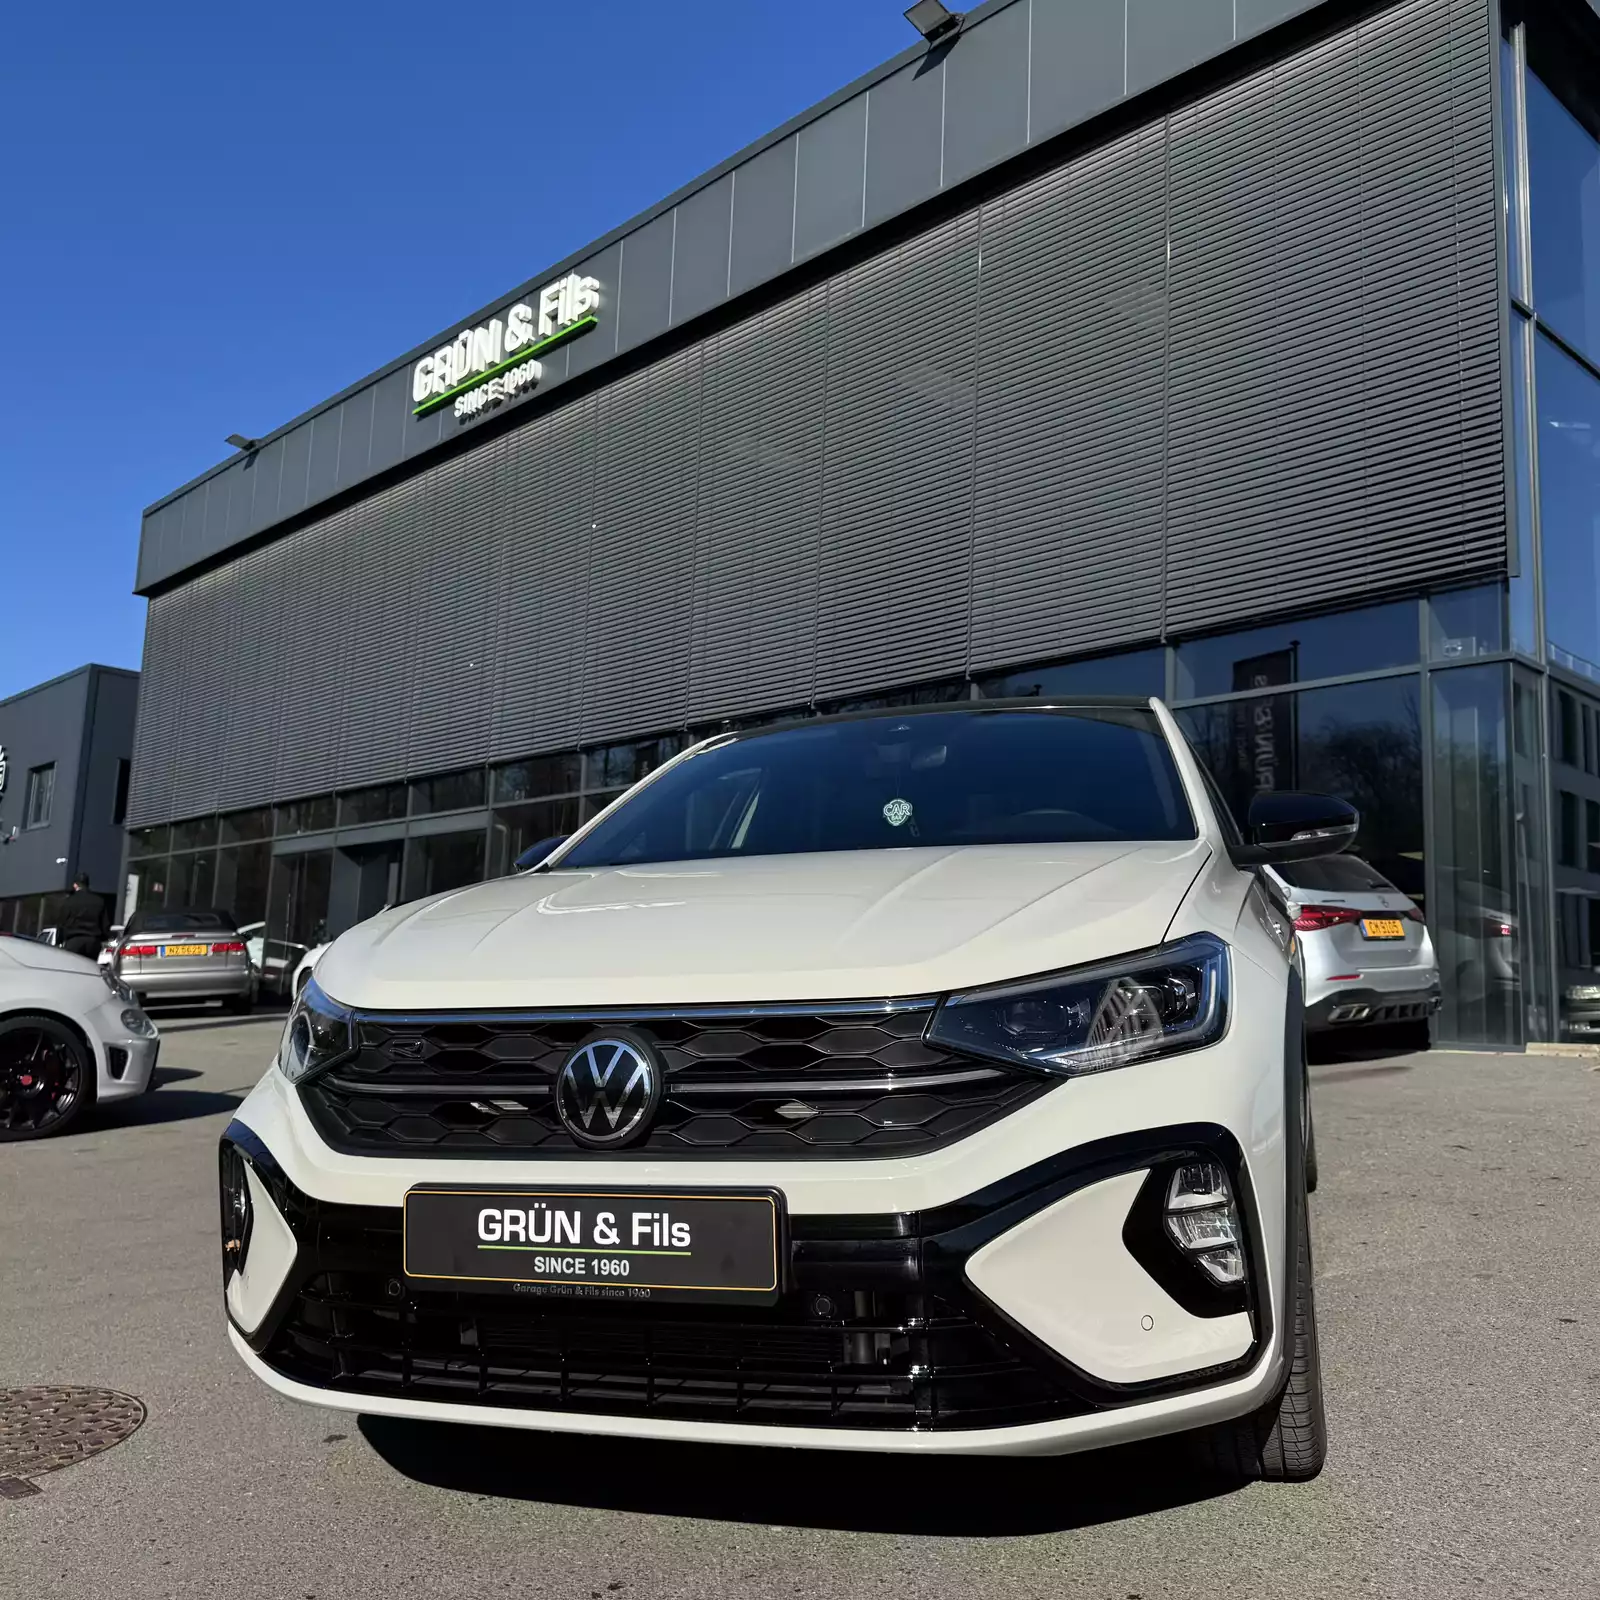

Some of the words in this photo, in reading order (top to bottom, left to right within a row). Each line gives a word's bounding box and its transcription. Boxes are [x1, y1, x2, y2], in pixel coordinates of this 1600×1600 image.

[413, 319, 502, 402] GRÜN
[505, 303, 536, 352] &
[539, 273, 600, 336] Fils
[454, 377, 504, 418] SINCE
[504, 359, 543, 395] 1960
[883, 803, 911, 816] CAR
[477, 1202, 581, 1245] GRÜN
[593, 1212, 621, 1245] &
[631, 1212, 691, 1247] Fils
[534, 1256, 586, 1275] SINCE
[591, 1258, 630, 1277] 1960
[513, 1283, 548, 1296] Garage
[550, 1285, 573, 1295] Grün
[575, 1287, 583, 1296] &
[584, 1287, 600, 1296] Fils
[601, 1287, 625, 1297] since
[627, 1288, 651, 1298] 1960
